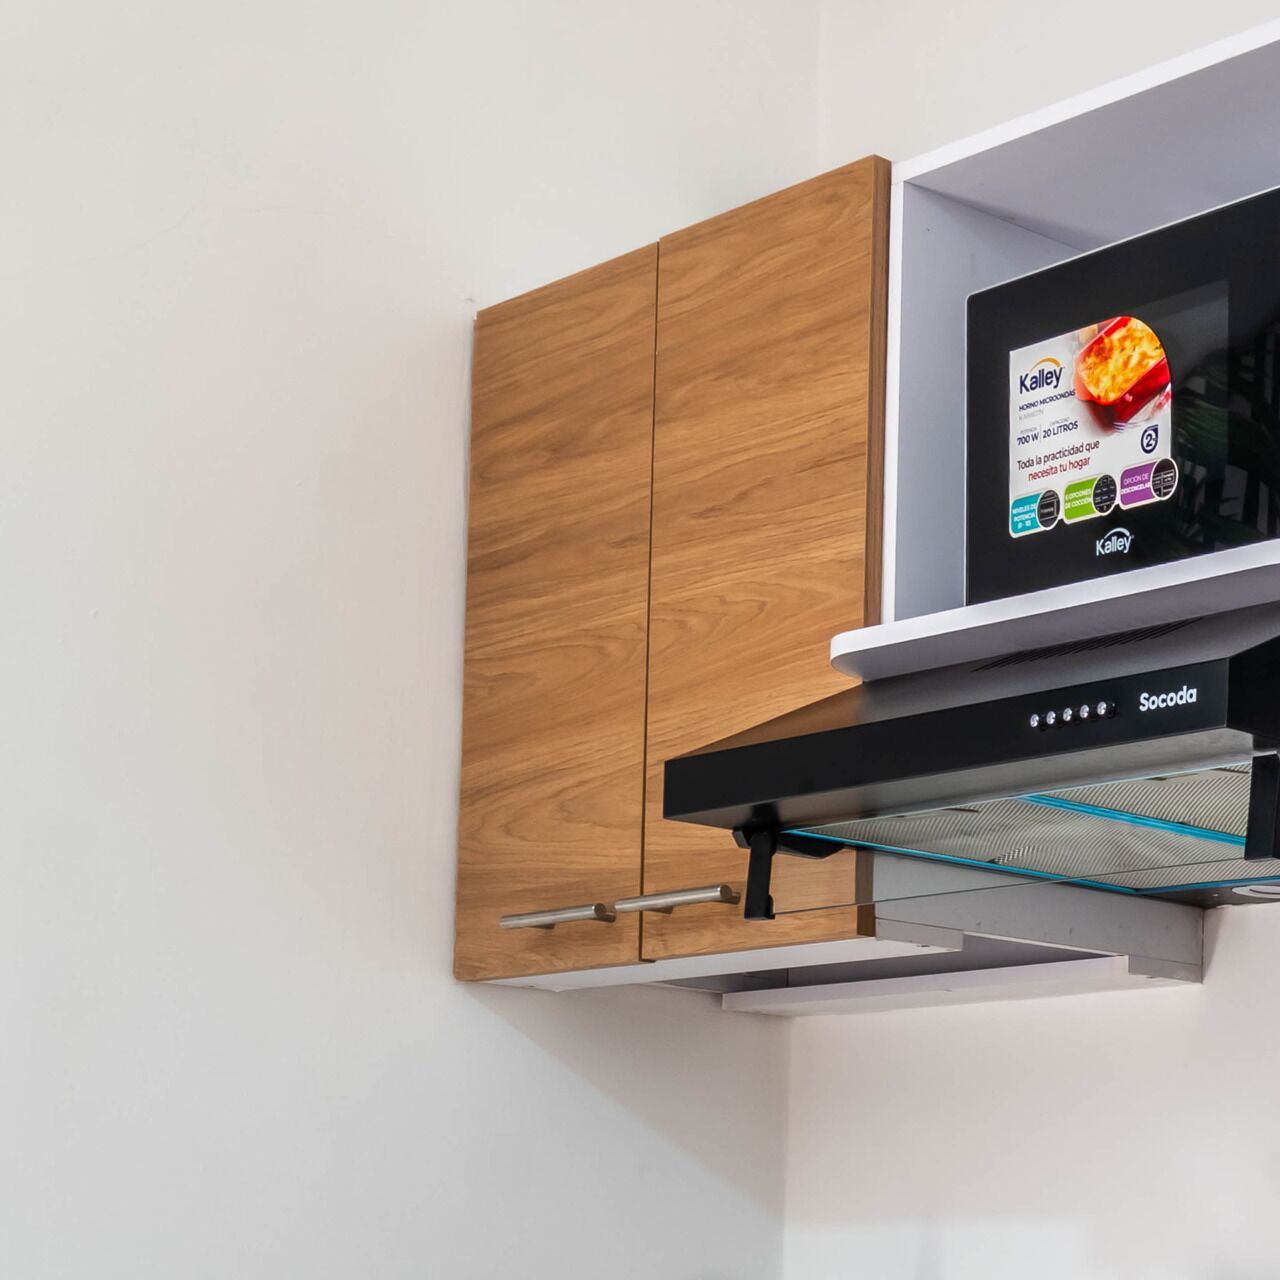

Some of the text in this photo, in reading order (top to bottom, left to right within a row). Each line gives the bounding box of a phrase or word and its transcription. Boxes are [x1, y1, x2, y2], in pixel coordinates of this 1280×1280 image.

[1019, 367, 1063, 394] Kalley
[1019, 389, 1076, 412] HORNO MICROONDAS
[1017, 432, 1039, 446] 700 W
[1043, 429, 1051, 439] 20
[1052, 421, 1078, 435] LITROS
[1145, 433, 1153, 447] 2
[1017, 440, 1100, 471] Toda la practicidad que
[1028, 457, 1090, 480] necesita tu hogar
[1096, 536, 1131, 556] Kalley
[1139, 685, 1197, 712] Socoda
